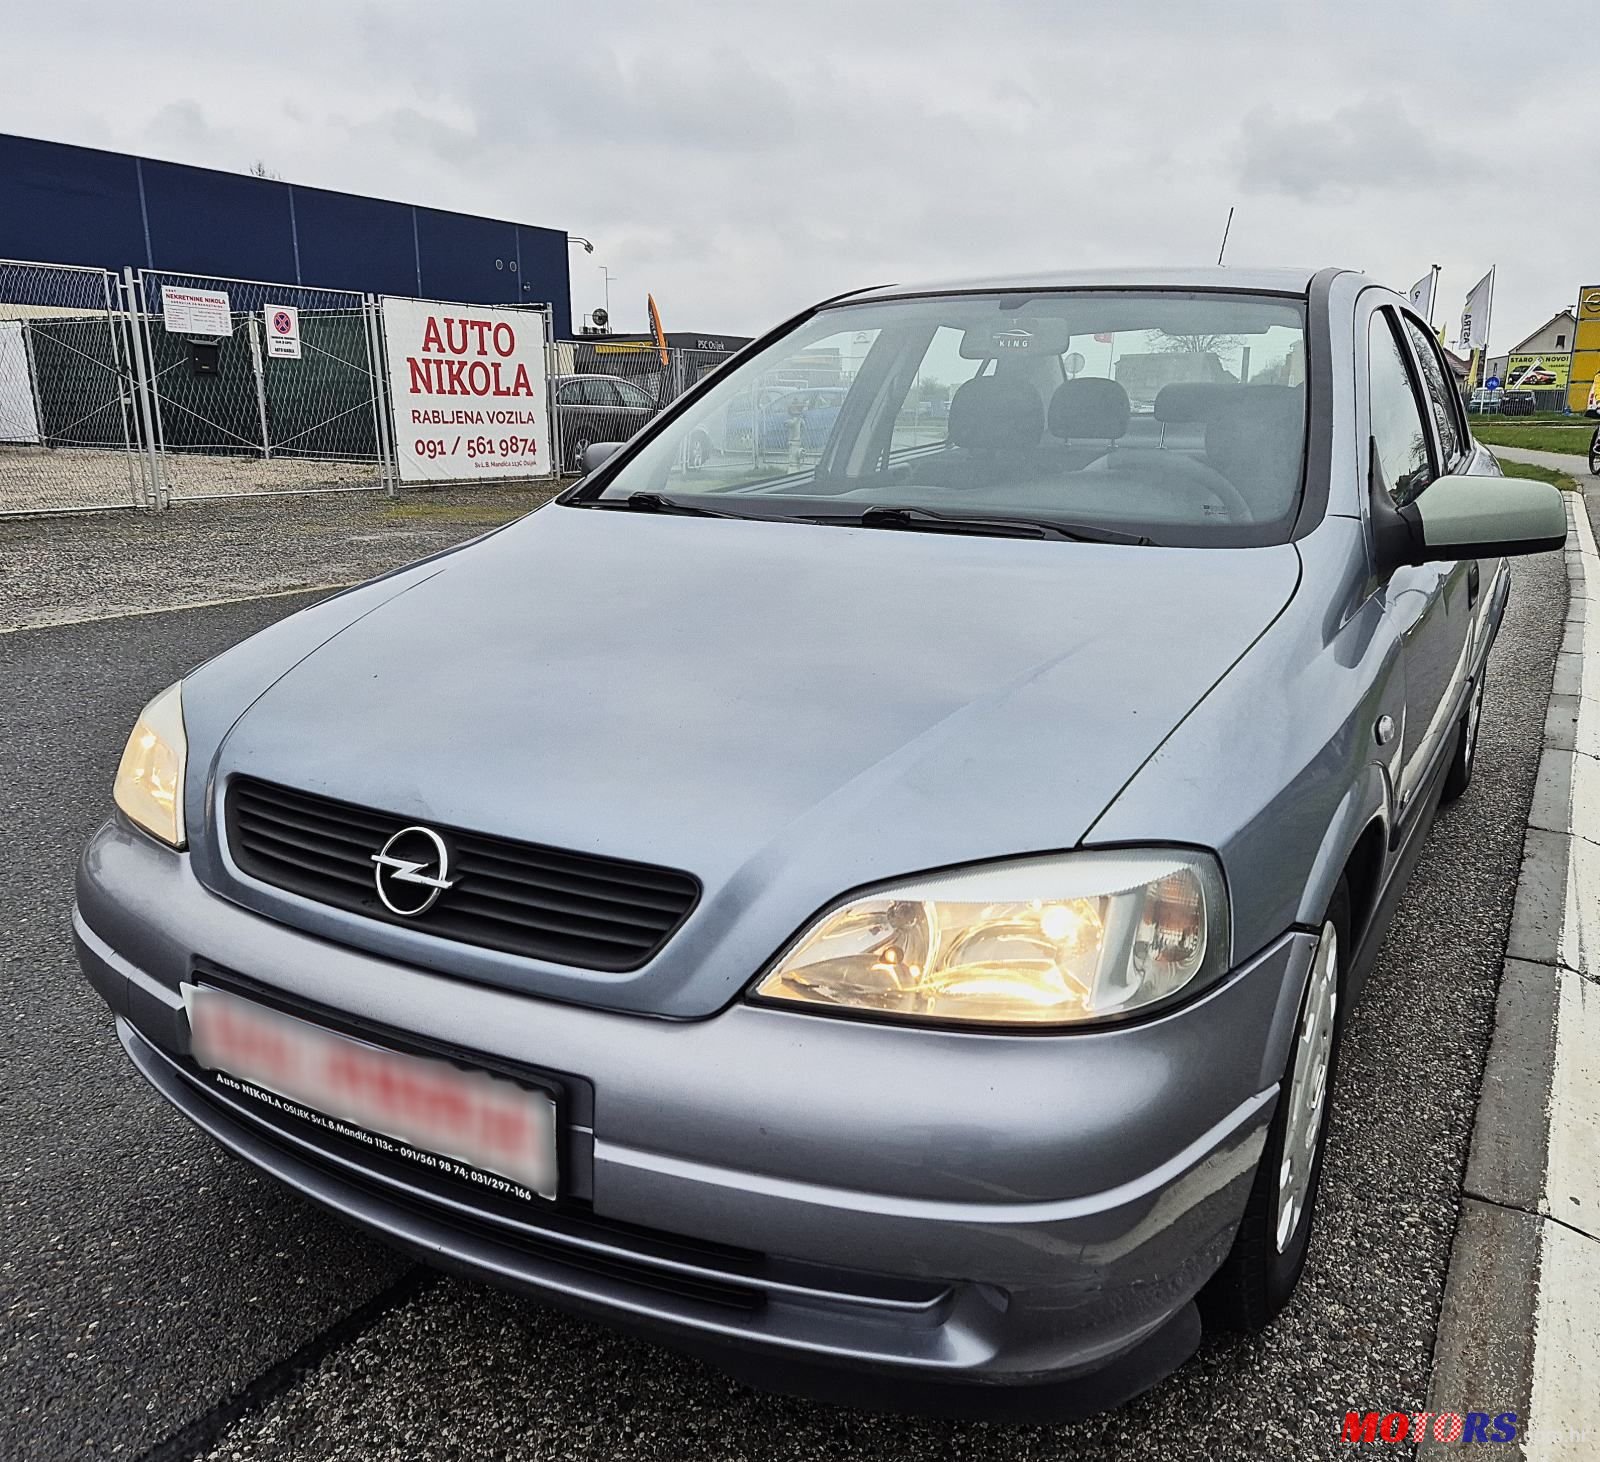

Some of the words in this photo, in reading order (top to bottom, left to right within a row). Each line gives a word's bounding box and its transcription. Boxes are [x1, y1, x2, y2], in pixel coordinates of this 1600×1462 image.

[165, 293, 204, 303] NEKRETNINE
[204, 297, 226, 305] NIKOLA
[422, 316, 515, 357] AUTO
[697, 339, 708, 349] PSC
[999, 339, 1028, 347] KING
[406, 357, 534, 397] NIKOLA
[411, 409, 484, 424] RABLJENA
[486, 411, 535, 424] VOZILA
[414, 439, 446, 459] 091
[451, 436, 461, 455] /
[467, 436, 495, 458] 561
[499, 435, 537, 457] 9874
[216, 1073, 241, 1090] Auto
[241, 1083, 282, 1109] NIKOLA
[283, 1102, 310, 1120] OSIJEK
[375, 1137, 393, 1152] 113c
[400, 1147, 437, 1167] 091/561
[438, 1160, 451, 1172] 98
[453, 1165, 469, 1180] 74;
[471, 1171, 532, 1201] 031/297-166
